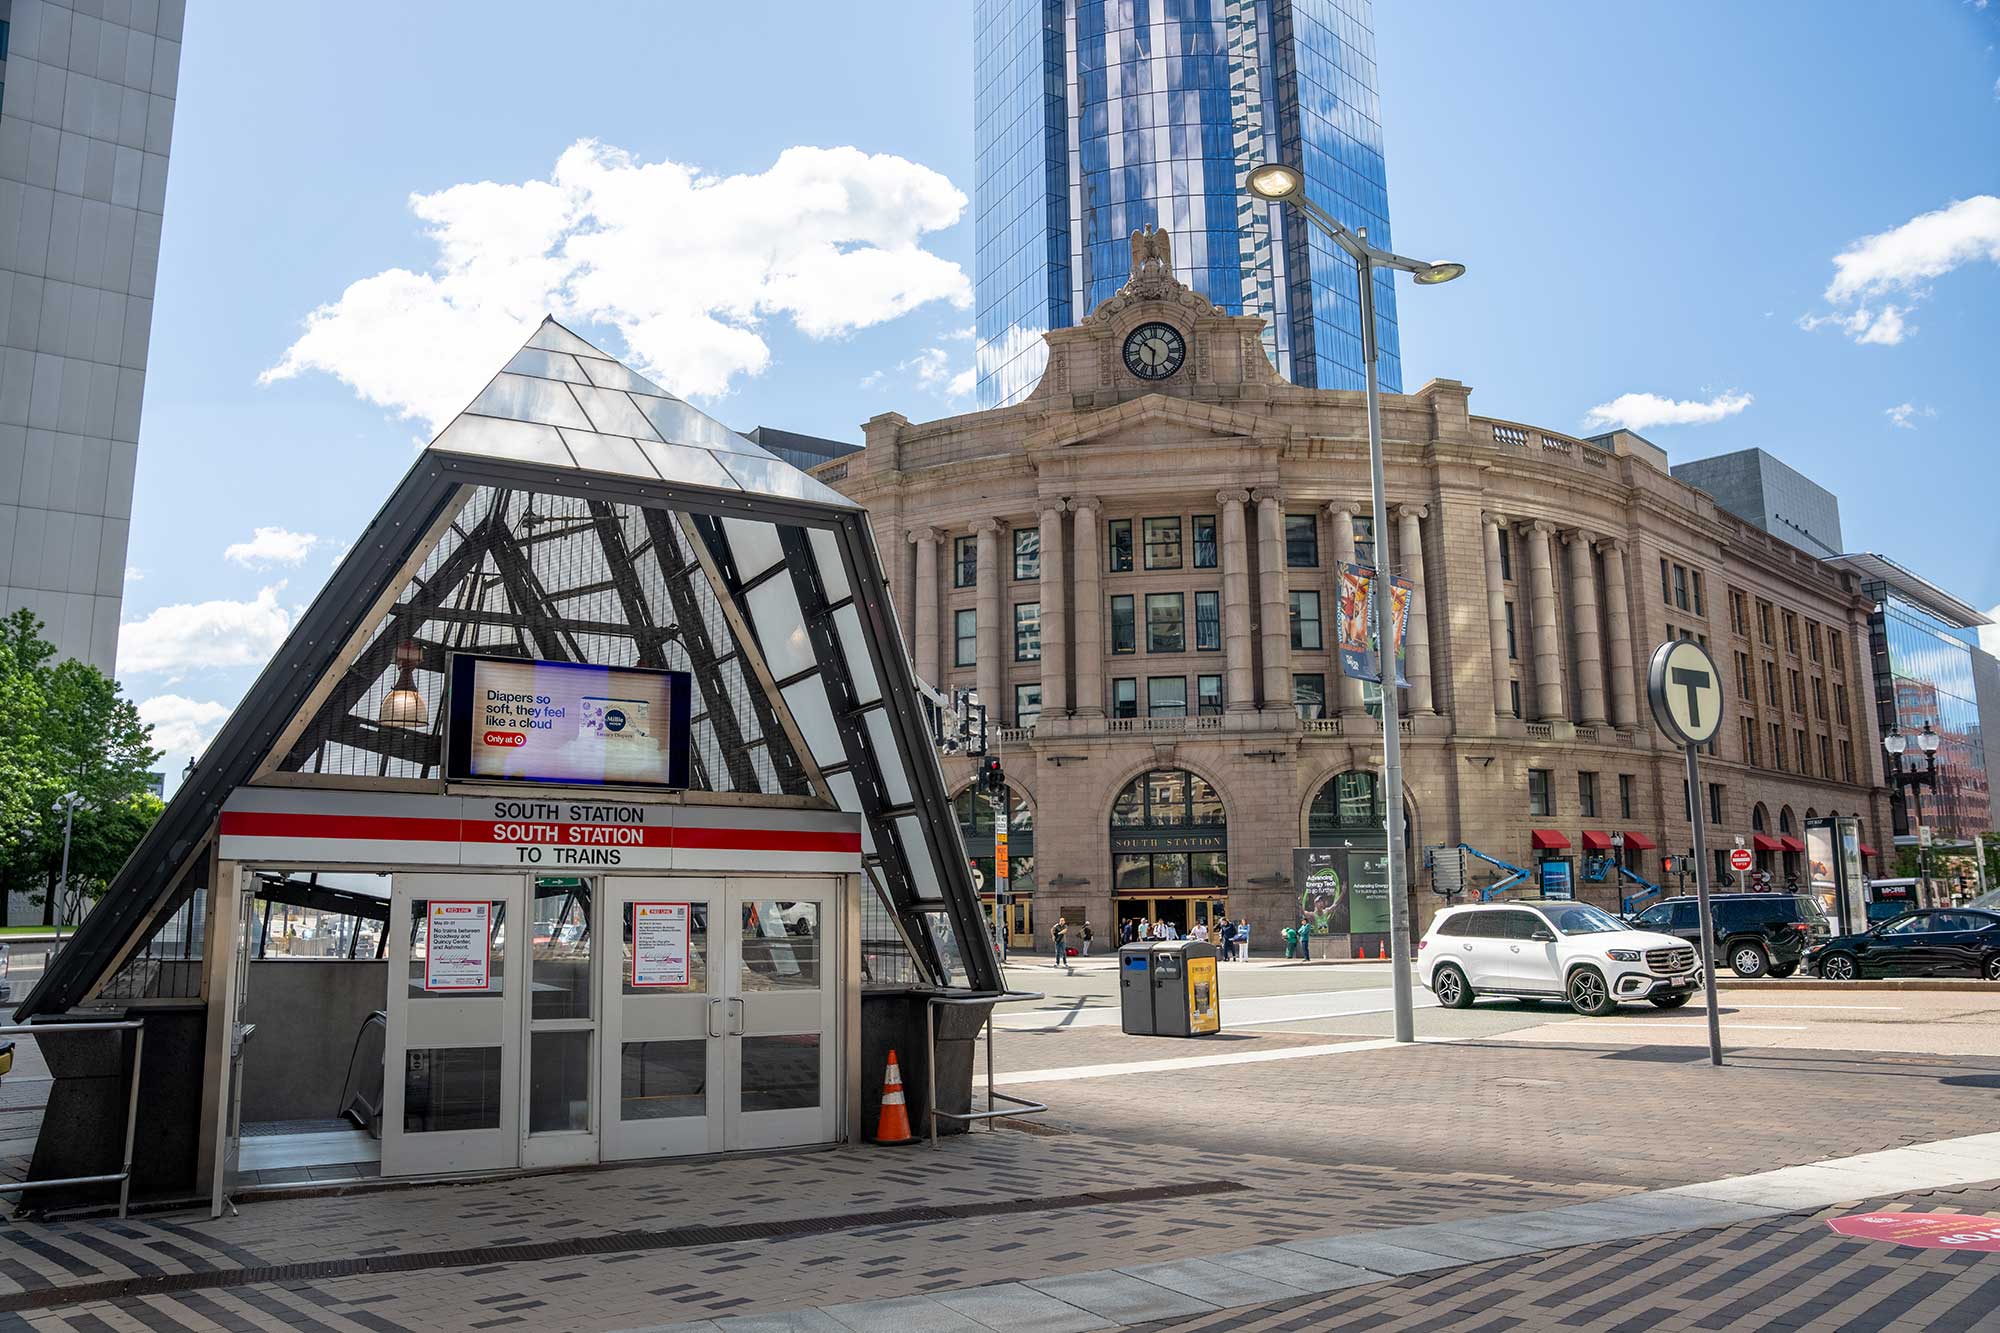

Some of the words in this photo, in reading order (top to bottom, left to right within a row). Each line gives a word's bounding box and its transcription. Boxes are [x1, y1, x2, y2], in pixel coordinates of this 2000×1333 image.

[1401, 590, 1412, 636] BIENVENUE
[487, 690, 533, 704] Diapers
[536, 695, 551, 704] so
[1672, 667, 1710, 727] T
[486, 704, 513, 716] soft,
[516, 705, 541, 718] they
[544, 706, 565, 717] feel
[486, 715, 505, 726] like
[509, 719, 516, 727] a
[519, 718, 552, 729] cloud
[487, 735, 504, 744] Only
[494, 802, 559, 820] SOUTH
[570, 805, 644, 823] STATION
[493, 824, 558, 842] SOUTH
[569, 826, 643, 844] STATION
[1116, 839, 1158, 847] SOUTH
[1167, 837, 1221, 846] STATION
[516, 847, 542, 863] TO
[553, 848, 621, 865] TRAINS
